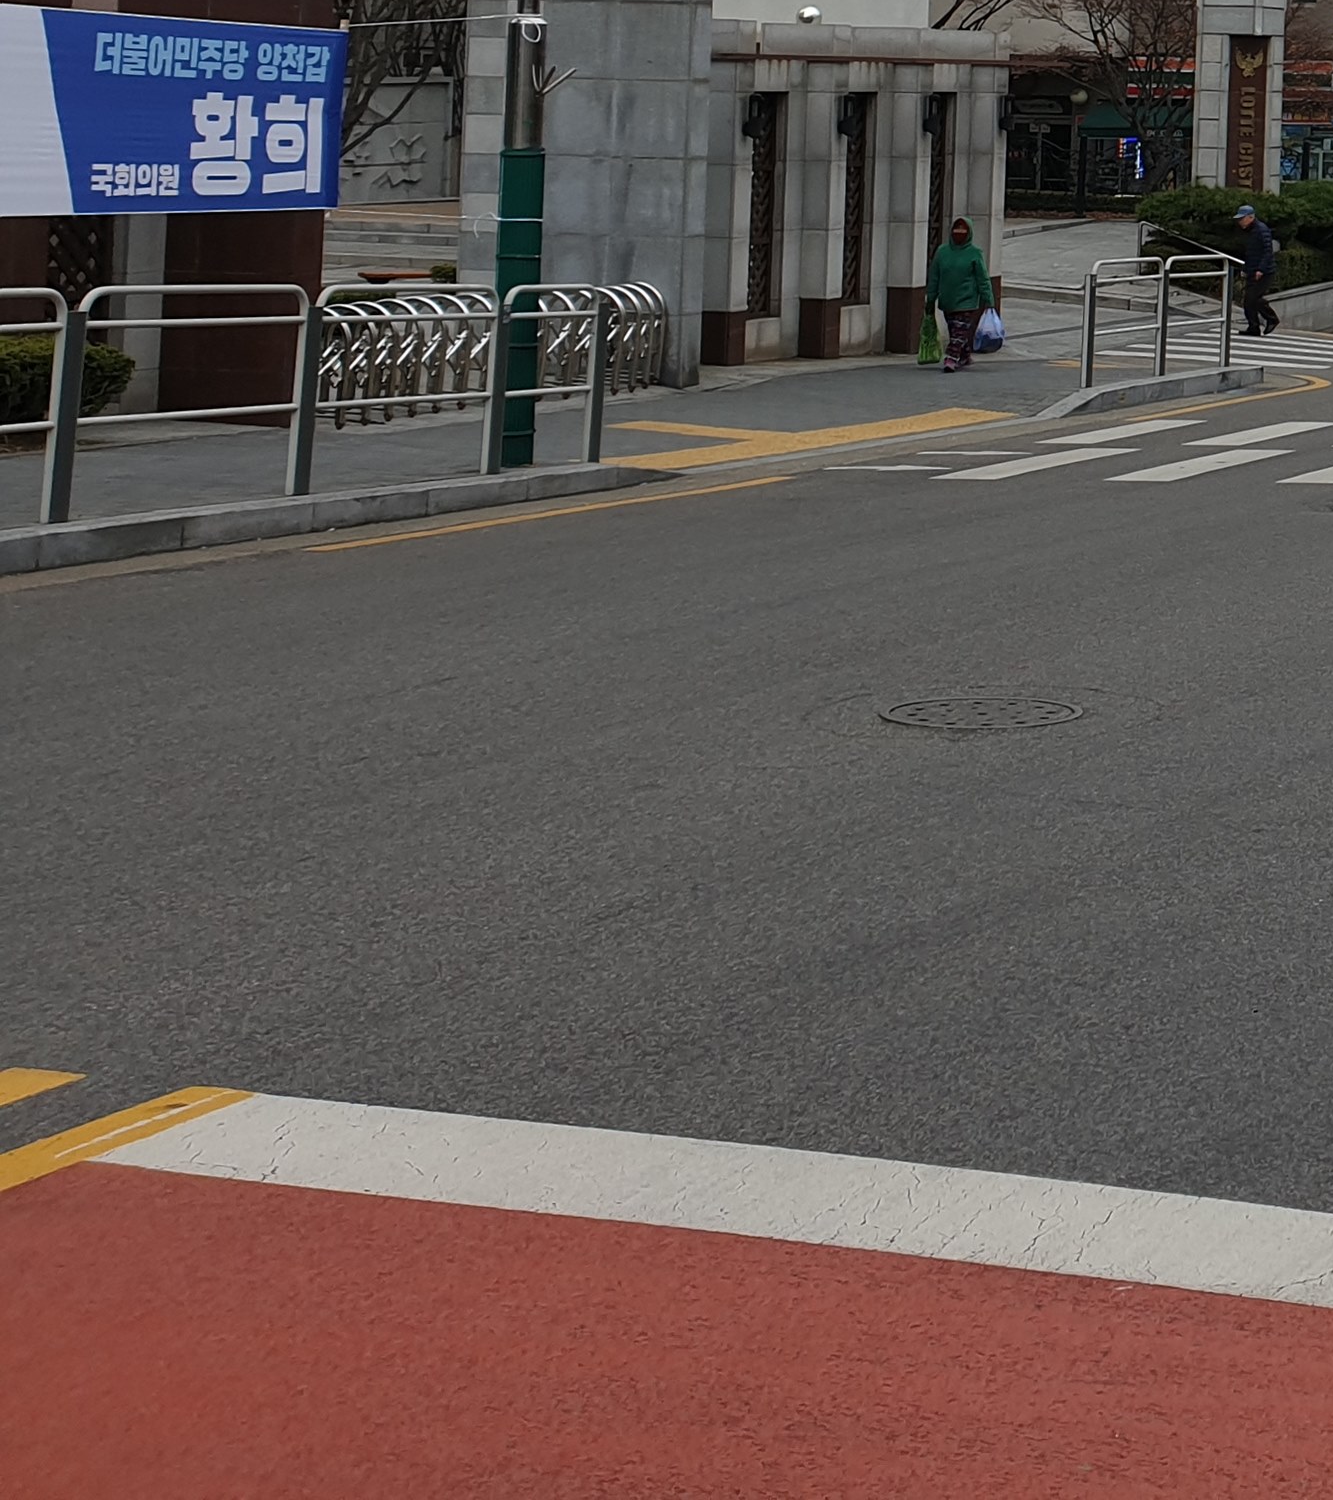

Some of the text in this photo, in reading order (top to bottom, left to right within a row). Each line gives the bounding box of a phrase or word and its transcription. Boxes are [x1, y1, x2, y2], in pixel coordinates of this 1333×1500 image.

[95, 31, 331, 83] 더불어민주당 양천갑
[190, 92, 325, 196] 황희
[1238, 87, 1256, 192] LOTTE CAST
[90, 163, 180, 198] 국회의원
